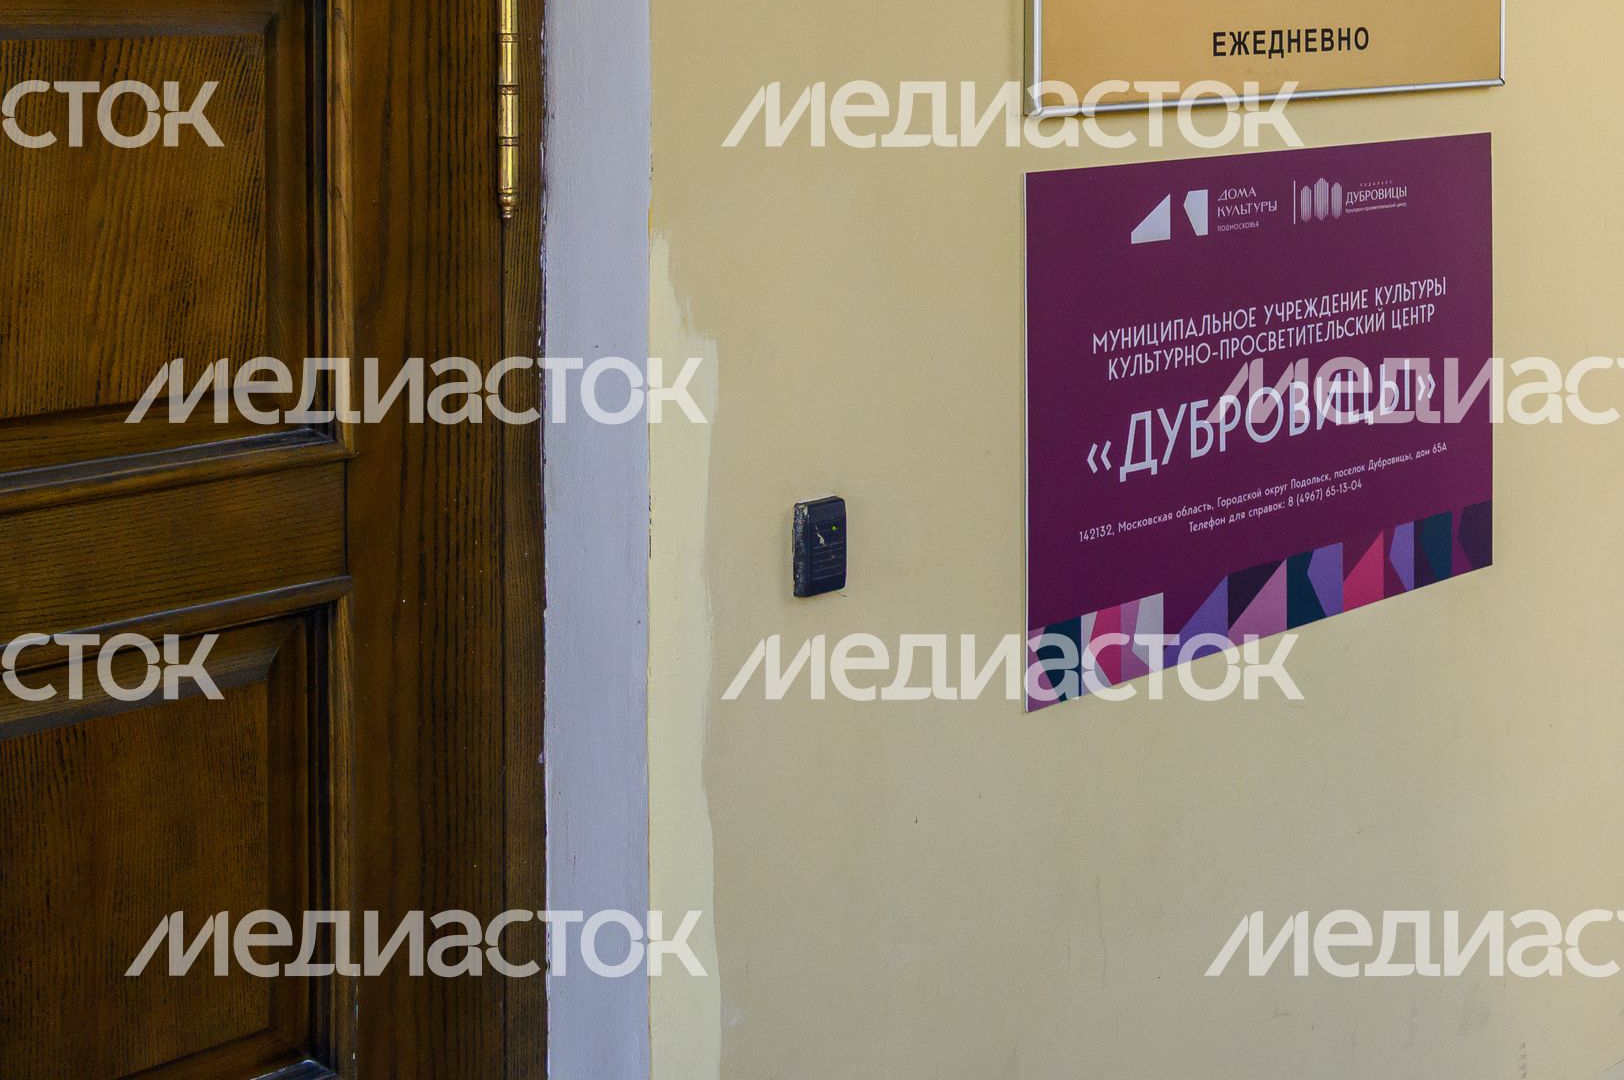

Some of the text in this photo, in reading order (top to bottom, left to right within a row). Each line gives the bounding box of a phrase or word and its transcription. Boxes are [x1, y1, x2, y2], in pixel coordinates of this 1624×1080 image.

[1212, 26, 1370, 60] ЕЖЕДНЕВНО
[1217, 186, 1257, 202] ДОМА
[1217, 200, 1278, 218] КУЛЬТУРЫ
[1345, 185, 1408, 206] ДУБРОВИЦЫ
[1091, 276, 1447, 354] МУНИЦИПАЛЬНОЕ УЧРЕЖДЕНИЕ КУЛЬТУРЫ
[1108, 304, 1435, 381] КУЛЬТУРНО-ПРОСВЕТИТЕЛЬСКИЙ ЦЕНТР
[1086, 358, 1436, 483] «ДУБРОВИЦЫ»
[1079, 524, 1115, 543] 142132,
[1118, 511, 1173, 534] Московская
[1175, 502, 1214, 518] область,
[1217, 488, 1262, 510] Городской
[1265, 483, 1287, 497] округ
[1290, 473, 1331, 490] Подольск,
[1334, 464, 1366, 479] поселок
[1368, 452, 1413, 472] Дубровицы,
[1415, 449, 1430, 460] дом
[1189, 478, 1362, 533] Телефон для справок: 8 (4967) 65-13-04
